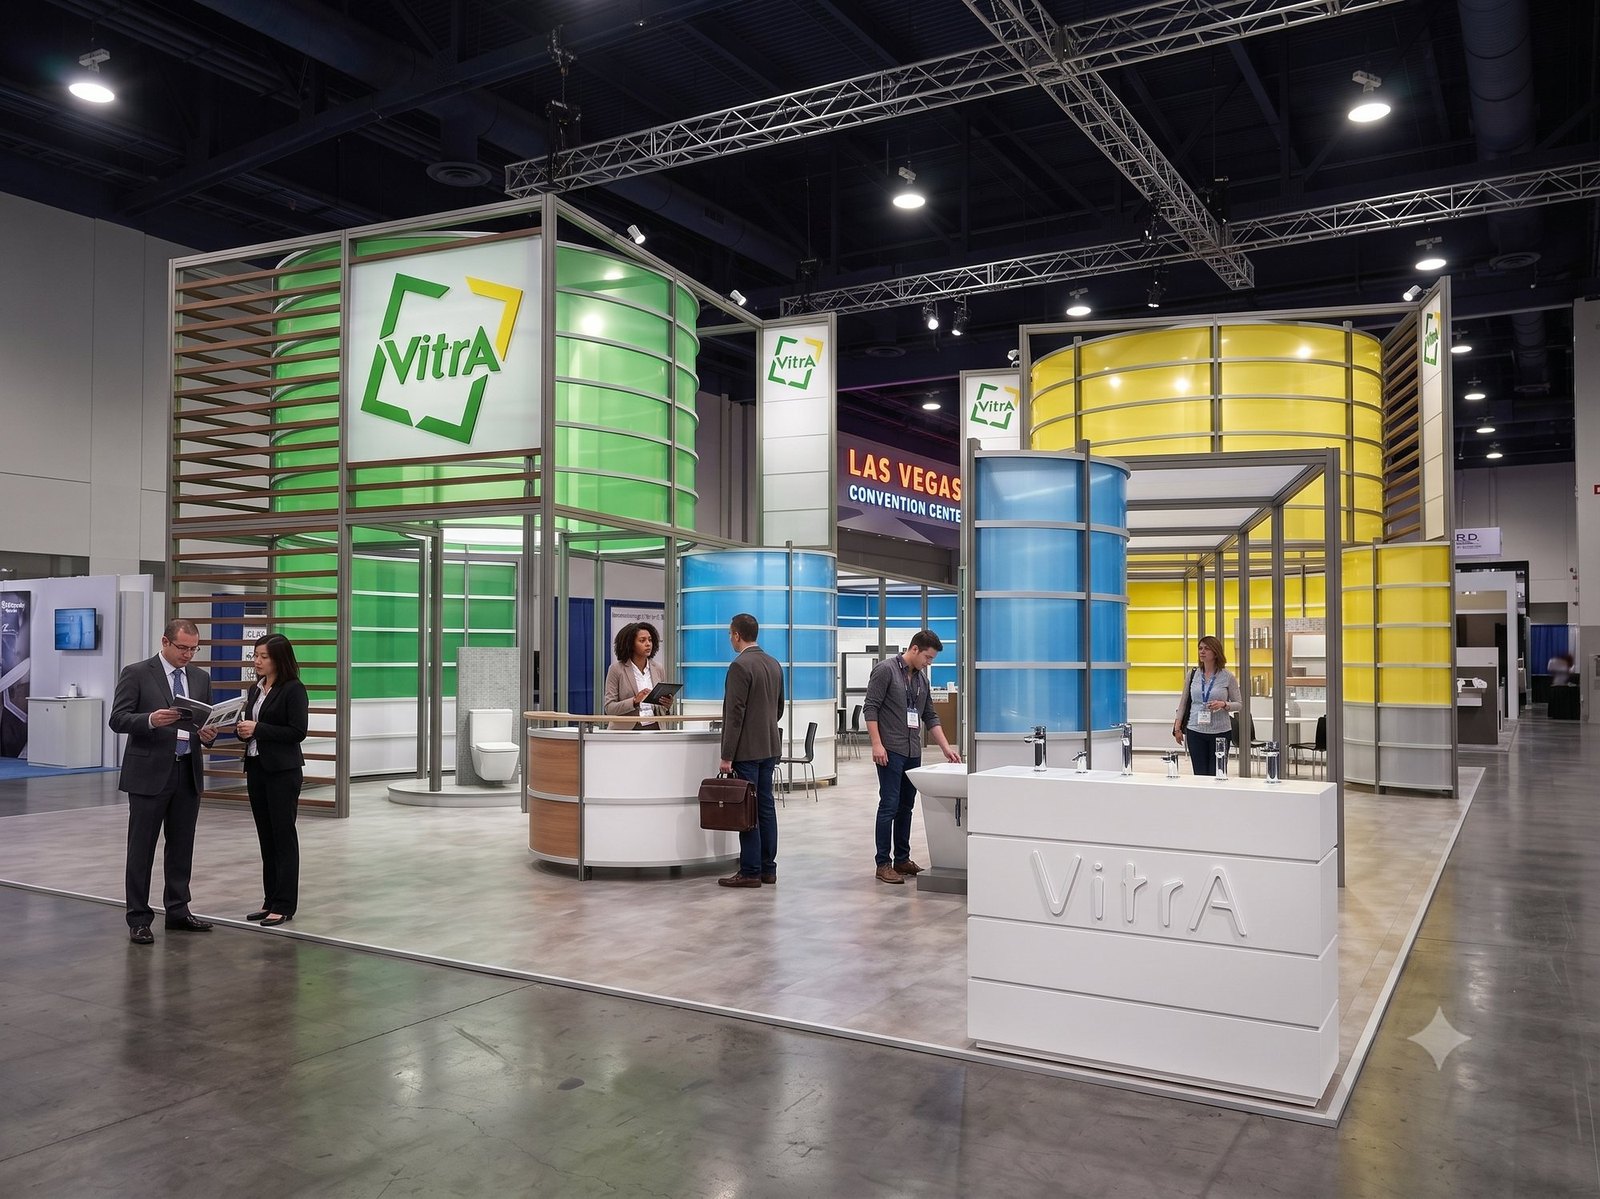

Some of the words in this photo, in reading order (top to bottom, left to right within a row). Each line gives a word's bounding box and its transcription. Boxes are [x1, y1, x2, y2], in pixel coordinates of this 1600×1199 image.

[384, 325, 501, 385] VitrA
[776, 354, 816, 369] VitrA
[978, 400, 1015, 412] VitrA
[849, 449, 891, 483] LAS
[898, 462, 961, 502] VEGAS
[849, 484, 926, 516] CONVENTION
[929, 502, 961, 524] CENTE
[1031, 848, 1248, 937] VitrA
